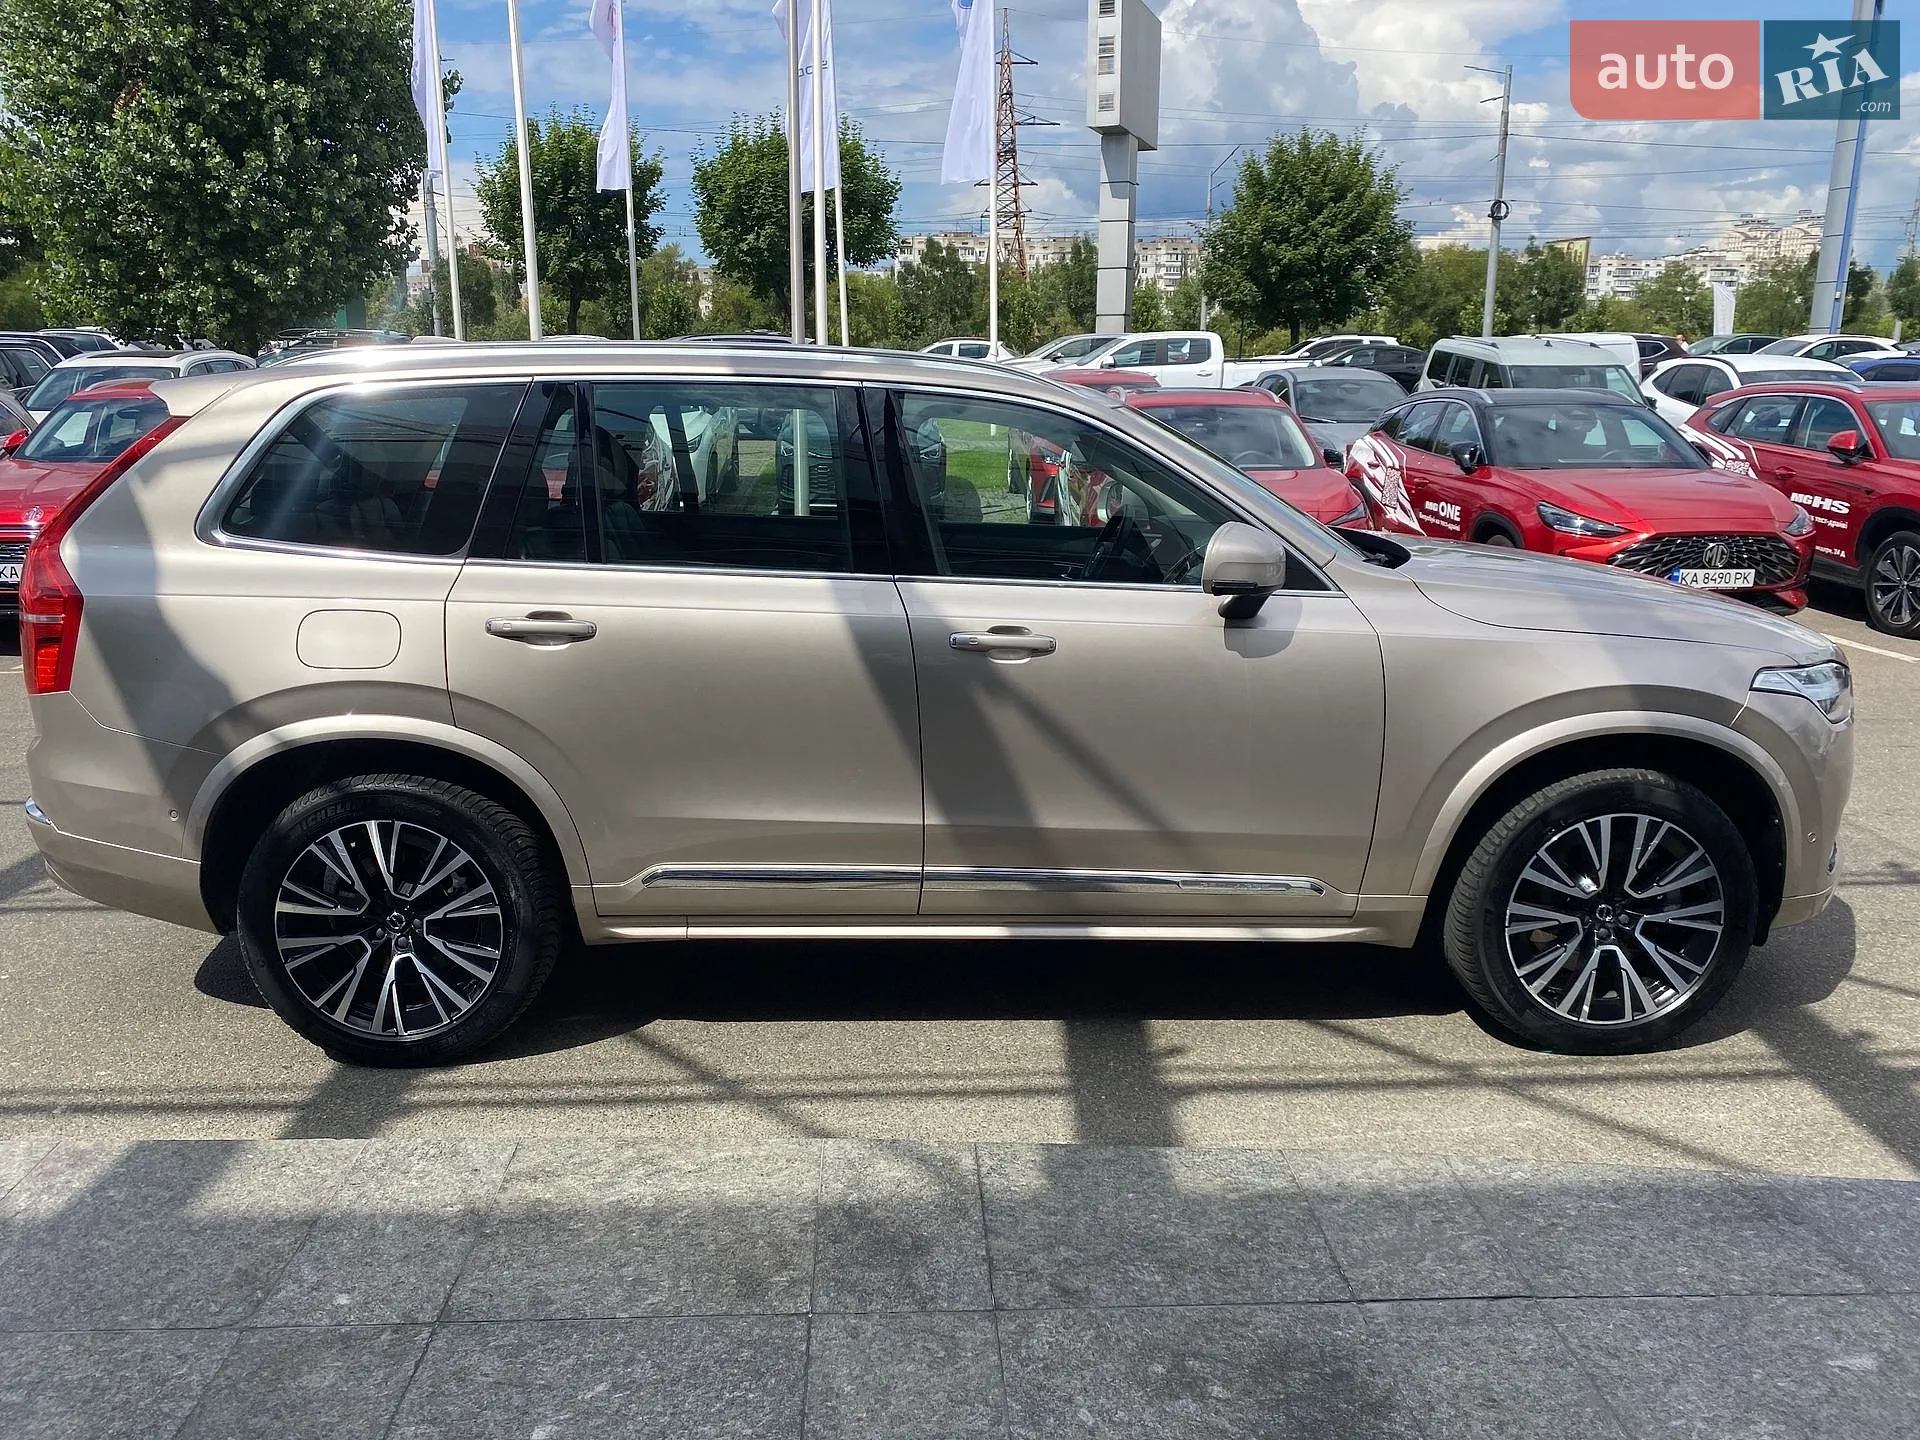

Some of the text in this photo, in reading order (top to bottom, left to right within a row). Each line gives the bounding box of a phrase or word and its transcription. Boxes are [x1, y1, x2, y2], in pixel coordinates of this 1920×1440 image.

[1705, 543, 1728, 567] MG
[1680, 572, 1752, 585] KA 8490 PK
